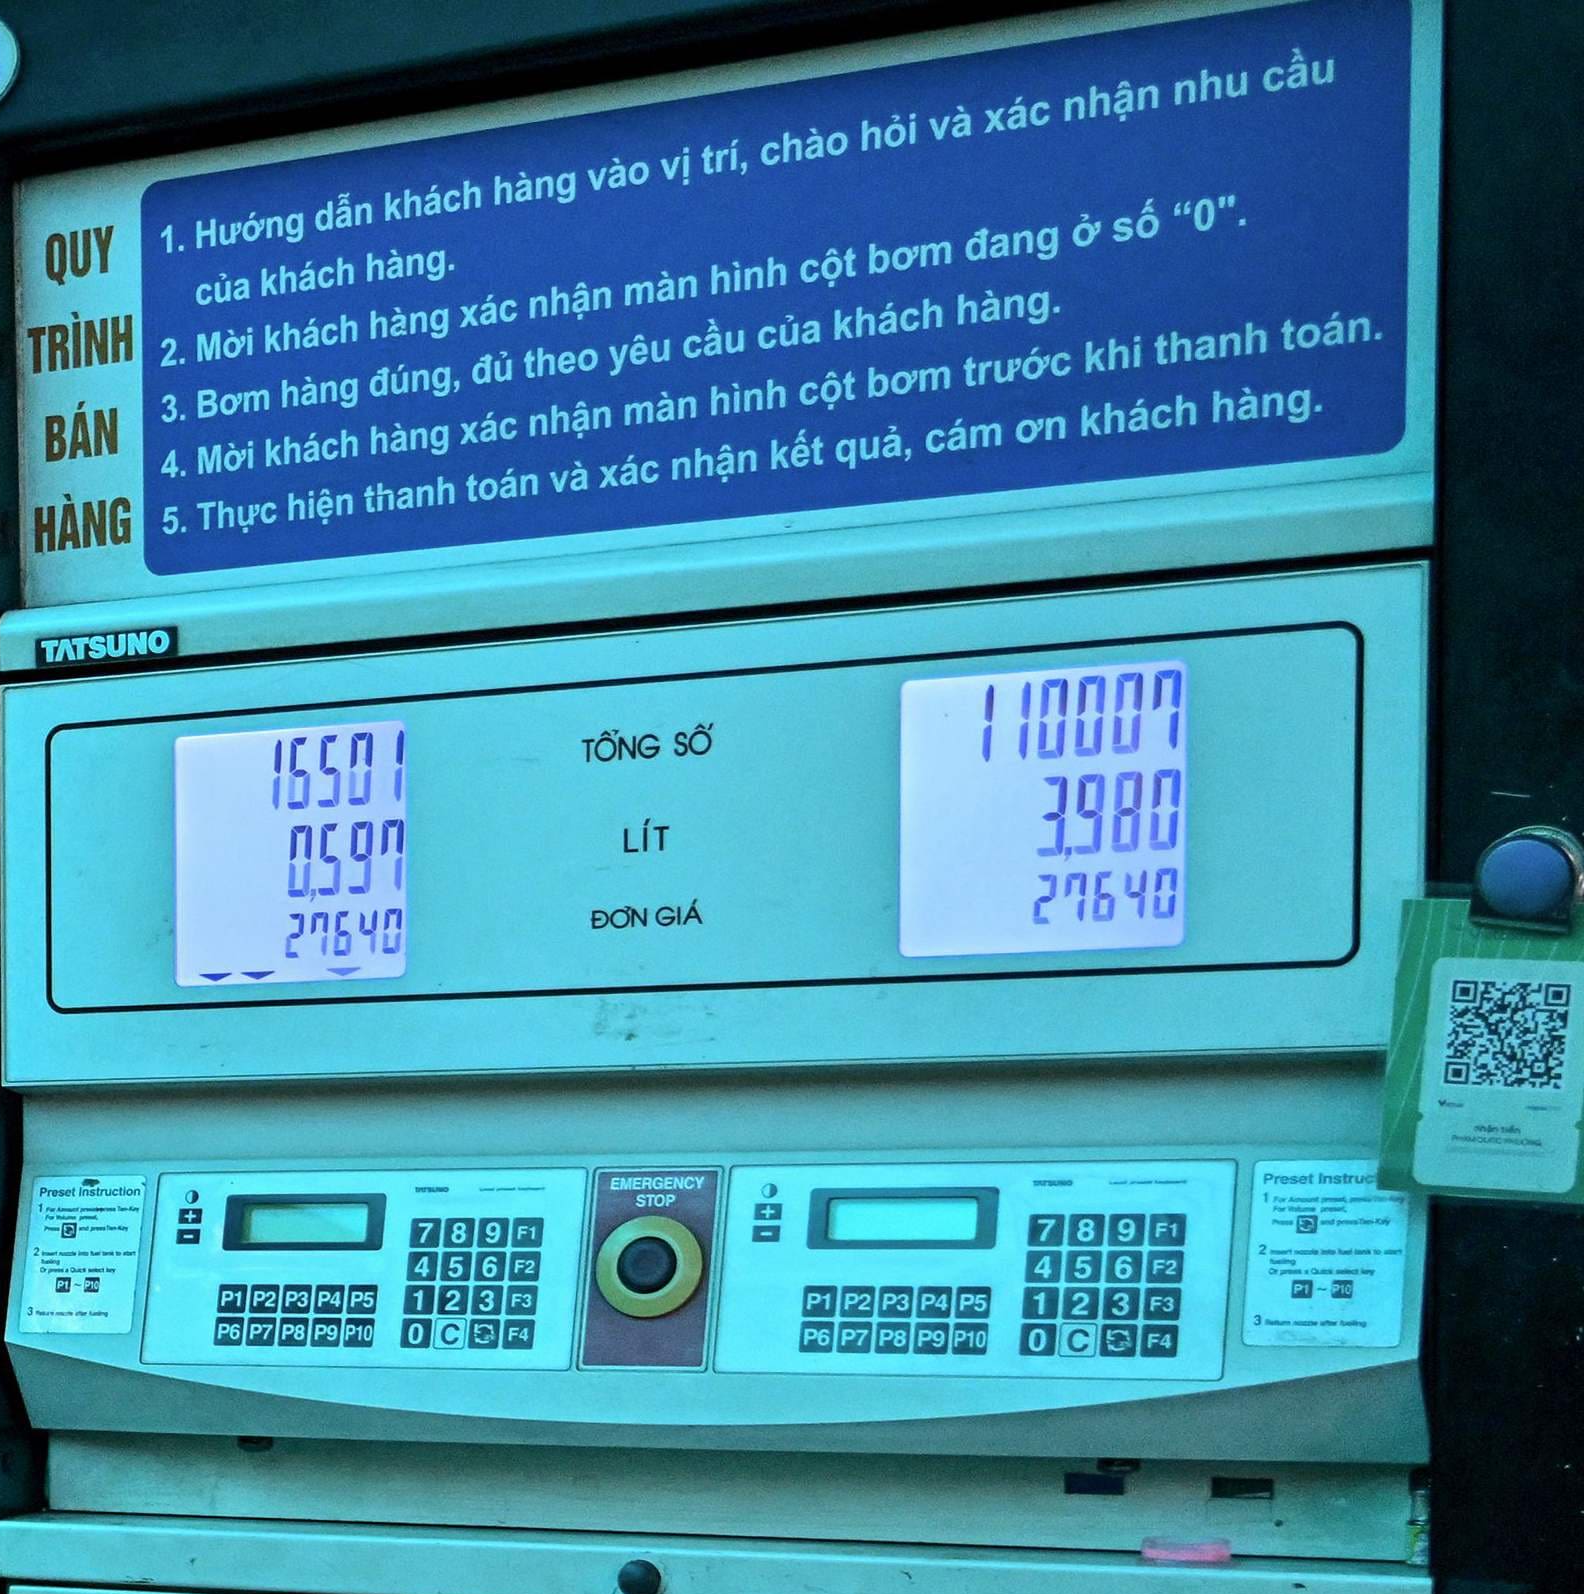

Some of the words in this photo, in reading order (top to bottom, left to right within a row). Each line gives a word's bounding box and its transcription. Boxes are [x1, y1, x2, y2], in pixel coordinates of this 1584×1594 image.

[160, 224, 185, 254] 1.
[195, 211, 305, 250] Hướng
[314, 192, 373, 232] dẫn
[384, 179, 482, 222] khách
[493, 171, 577, 206] hàng
[586, 157, 650, 191] vào
[659, 146, 690, 186] vị
[700, 138, 748, 176] trí,
[760, 127, 849, 166] chào
[861, 112, 917, 152] hỏi
[928, 105, 972, 141] và
[983, 95, 1051, 134] xác
[1064, 80, 1160, 122] nhận
[1174, 68, 1248, 106] nhu
[1262, 45, 1335, 92] cầu
[44, 225, 113, 286] QUY
[160, 337, 186, 368] 2.
[196, 326, 254, 363] Mời
[264, 313, 359, 354] khách
[369, 306, 450, 340] hàng
[459, 293, 518, 329] xác
[528, 281, 612, 321] nhận
[624, 270, 698, 307] màn
[710, 256, 788, 296] hình
[799, 247, 857, 288] cột
[868, 241, 953, 275] bơm
[964, 225, 1059, 262] đang
[1071, 213, 1102, 248] ở
[1112, 197, 1160, 242] số
[195, 272, 251, 306] của
[260, 256, 355, 297] khách
[366, 248, 456, 283] hàng.
[27, 312, 133, 374] TRÌNH
[160, 393, 187, 424] 3.
[196, 388, 271, 419] Bơm
[281, 375, 359, 409] hàng
[368, 363, 461, 398] đúng,
[471, 350, 513, 385] đủ
[523, 346, 599, 379] theo
[608, 333, 671, 377] yêu
[682, 317, 746, 359] cầu
[757, 314, 821, 350] của
[833, 297, 944, 341] khách
[957, 289, 1061, 326] hàng.
[160, 448, 187, 479] 4.
[197, 440, 255, 475] Mời
[264, 428, 359, 468] khách
[370, 422, 450, 456] hàng
[459, 411, 518, 445] xác
[528, 400, 612, 440] nhận
[623, 391, 698, 426] màn
[710, 378, 787, 417] hình
[798, 370, 856, 411] cột
[867, 365, 951, 399] bơm
[962, 346, 1072, 387] trước
[1085, 335, 1142, 374] khi
[1153, 321, 1268, 366] thanh
[1280, 311, 1382, 351] toán.
[45, 401, 118, 462] BÁN
[161, 505, 187, 535] 5.
[196, 500, 278, 534] Thực
[287, 488, 354, 526] hiện
[363, 475, 456, 513] thanh
[465, 467, 539, 503] toán
[549, 460, 589, 493] và
[598, 454, 660, 489] xác
[671, 443, 758, 484] nhận
[770, 428, 824, 470] kết
[835, 425, 912, 470] quả,
[925, 417, 1003, 454] cám
[1015, 415, 1067, 444] ơn
[1080, 394, 1197, 437] khách
[1212, 386, 1323, 424] hàng.
[34, 493, 131, 553] HÀNG
[40, 630, 170, 663] TATSUNO
[982, 669, 1182, 763] 110007
[581, 729, 660, 763] TỔNG
[673, 722, 713, 757] SỐ
[272, 730, 404, 810] 16501
[623, 818, 670, 853] LÍT
[1033, 868, 1177, 924] 27640
[590, 906, 648, 929] ĐƠN
[655, 899, 703, 926] GIÁ
[285, 908, 403, 958] 27640
[39, 1187, 76, 1198] Preset
[78, 1186, 141, 1198] Instruction
[610, 1176, 705, 1190] EMERGENCY
[1263, 1173, 1314, 1185] Preset
[1318, 1173, 1378, 1185] Instruc
[635, 1194, 676, 1208] STOP
[418, 1222, 434, 1243] 7
[451, 1222, 466, 1244] 8
[485, 1222, 501, 1244] 9
[517, 1226, 536, 1240] F1
[1155, 1222, 1178, 1238] F1
[414, 1256, 430, 1278] 4
[448, 1256, 464, 1278] 5
[482, 1256, 498, 1278] 6
[514, 1260, 535, 1274] F2
[1152, 1259, 1176, 1274] F2
[220, 1291, 242, 1307] P1
[252, 1291, 276, 1307] P2
[284, 1291, 308, 1308] P3
[317, 1291, 341, 1308] P4
[350, 1291, 375, 1308] P5
[413, 1289, 424, 1311] 1
[444, 1290, 460, 1311] 2
[478, 1290, 494, 1312] 3
[511, 1294, 532, 1308] F3
[806, 1293, 831, 1310] P1
[844, 1293, 871, 1310] P2
[882, 1294, 910, 1312] P3
[920, 1294, 948, 1312] P4
[959, 1294, 988, 1312] P5
[1150, 1296, 1174, 1312] F3
[217, 1323, 240, 1340] P6
[249, 1324, 274, 1340] P7
[281, 1324, 305, 1340] P8
[314, 1324, 338, 1340] P9
[345, 1324, 373, 1341] P10
[408, 1322, 424, 1344] 0
[440, 1322, 460, 1345] C
[508, 1328, 529, 1342] F4
[803, 1328, 830, 1346] P6
[841, 1328, 869, 1346] P7
[879, 1329, 907, 1347] P8
[917, 1330, 945, 1348] P9
[954, 1330, 986, 1348] P10
